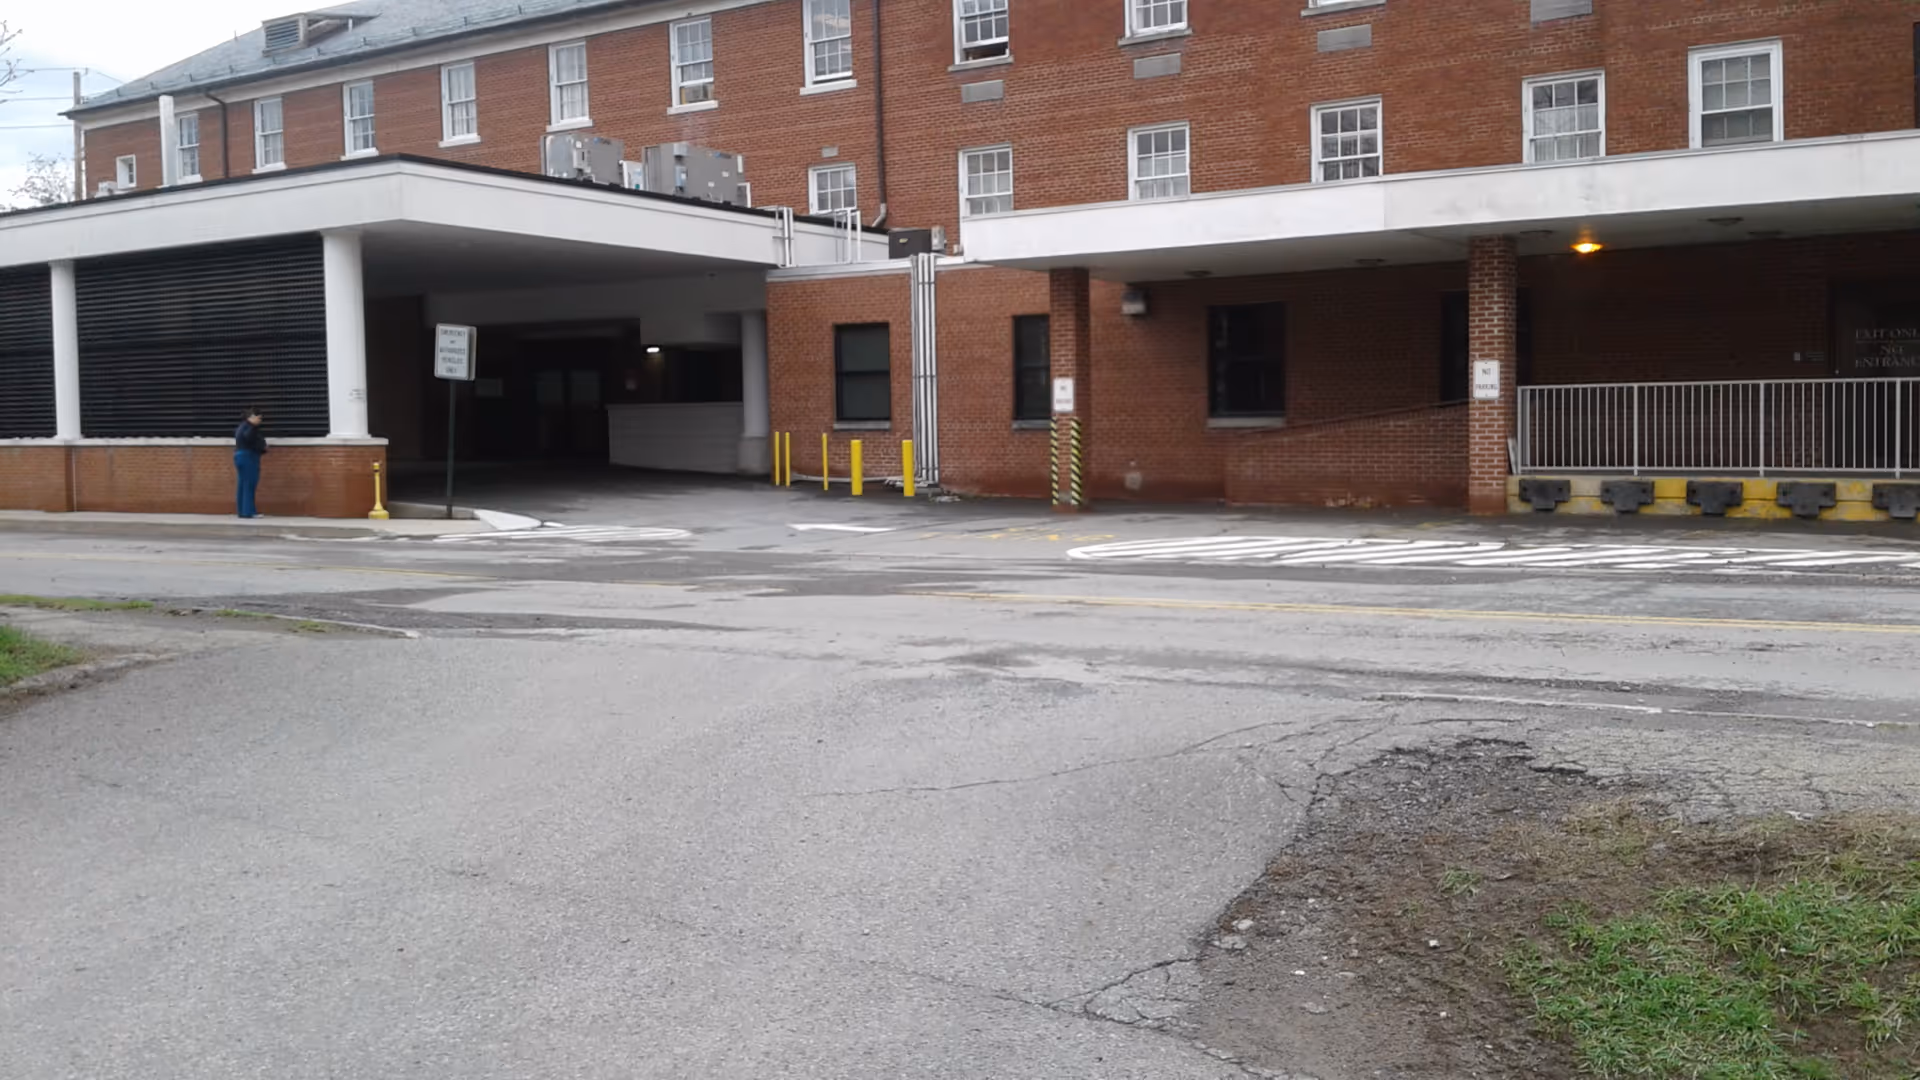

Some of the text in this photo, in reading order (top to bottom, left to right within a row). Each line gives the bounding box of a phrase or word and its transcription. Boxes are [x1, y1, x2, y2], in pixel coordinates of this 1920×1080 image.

[1855, 328, 1920, 338] EXIT ONL
[1855, 356, 1920, 369] ENTRANC
